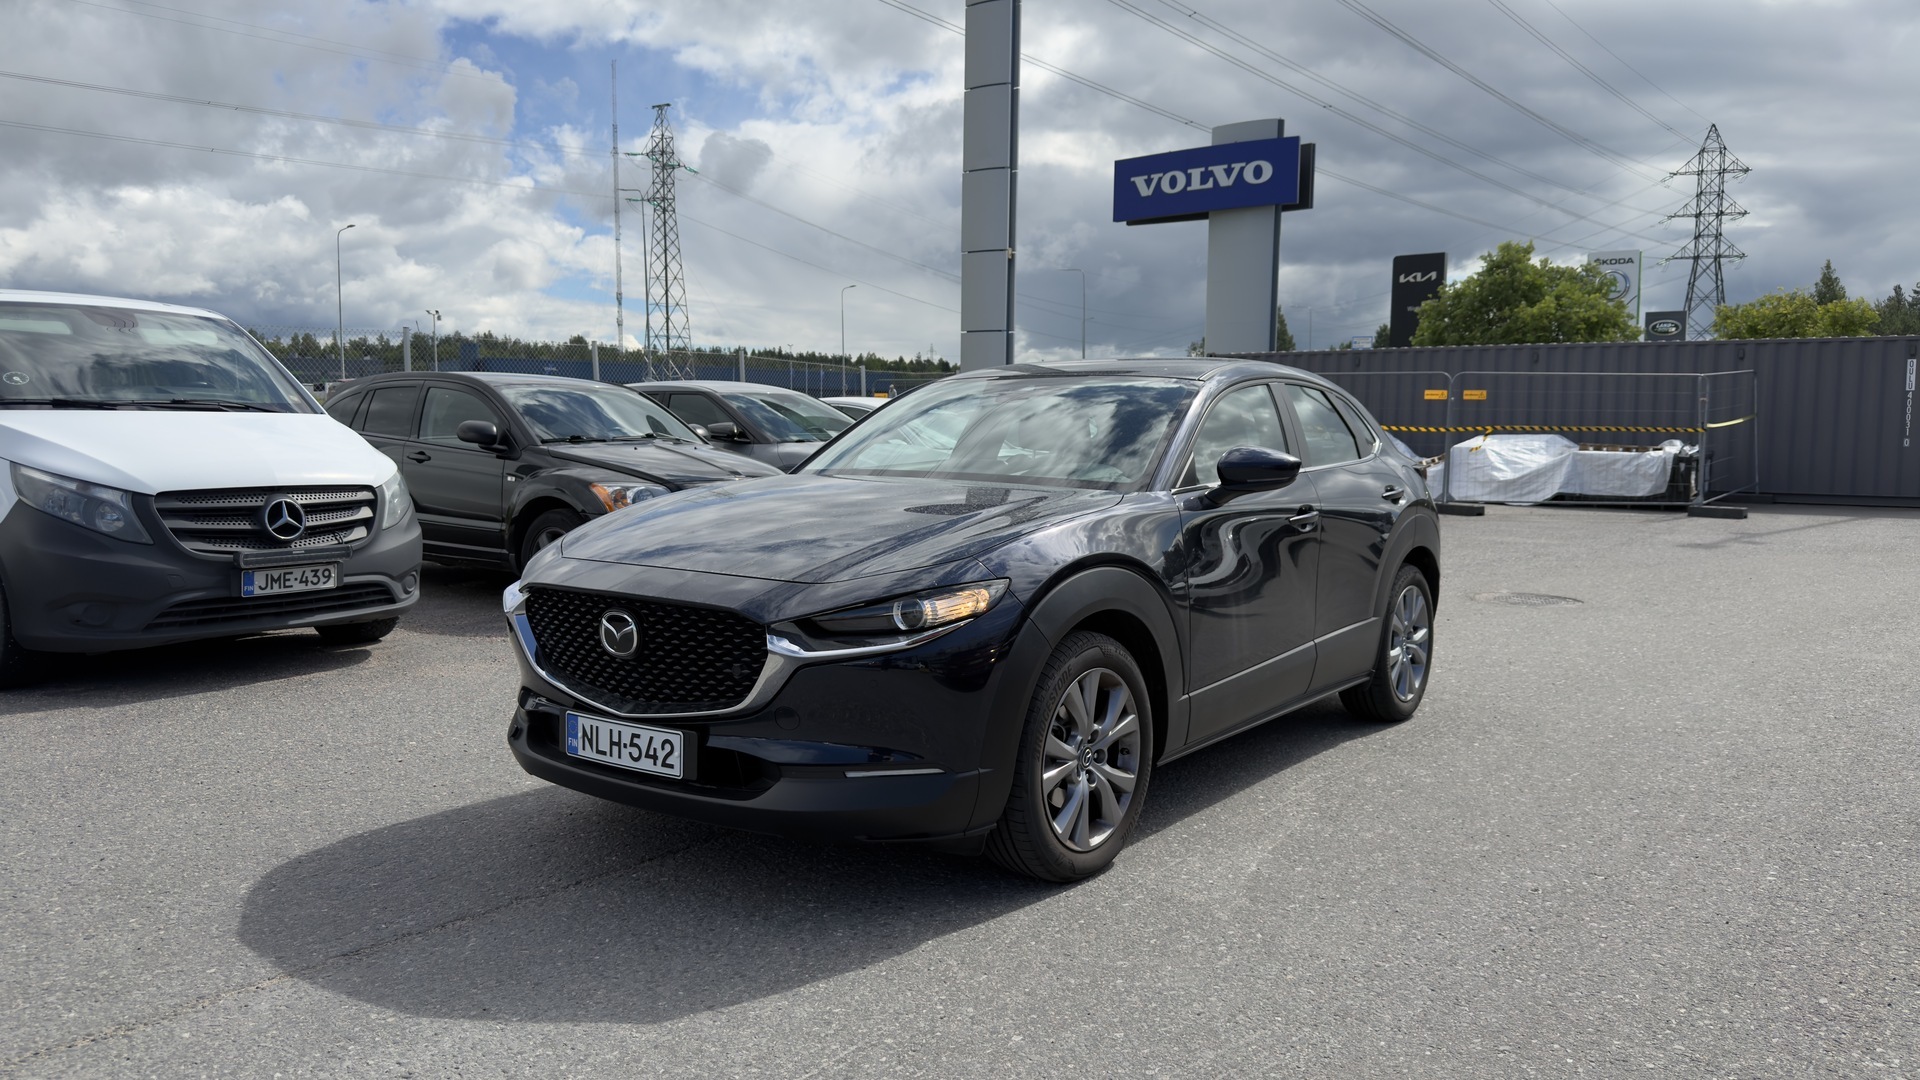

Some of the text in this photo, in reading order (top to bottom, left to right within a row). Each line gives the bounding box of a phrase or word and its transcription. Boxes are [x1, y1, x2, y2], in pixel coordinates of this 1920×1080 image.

[1131, 160, 1273, 197] VOLVO
[1399, 271, 1437, 283] KIA
[258, 568, 332, 591] JME-439
[1033, 663, 1074, 762] BRIDGESTONE
[568, 737, 578, 747] FIN
[581, 723, 675, 769] NLH-542
